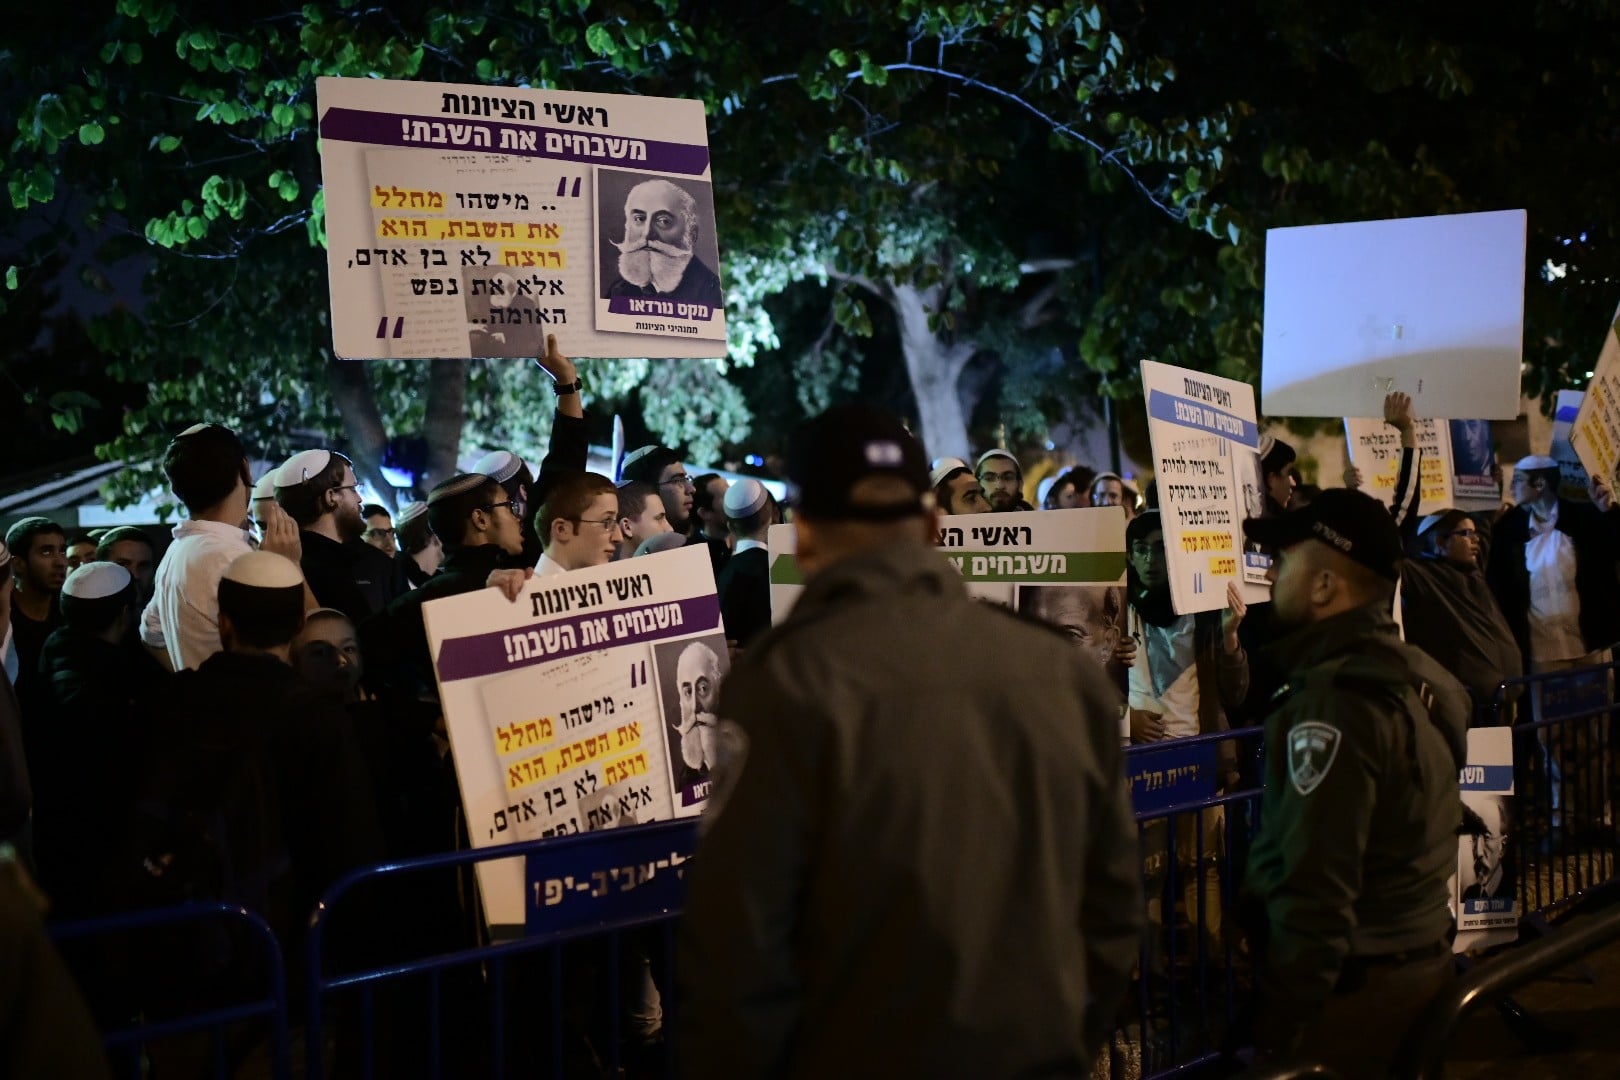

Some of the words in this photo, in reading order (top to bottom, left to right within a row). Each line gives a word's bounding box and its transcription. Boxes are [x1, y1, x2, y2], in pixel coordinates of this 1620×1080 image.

[441, 93, 536, 120] הציונות
[544, 102, 608, 127] ראשי
[401, 119, 491, 148] השבת!
[500, 128, 537, 151] את
[545, 132, 647, 161] משבחים
[375, 185, 443, 208] מחלל
[456, 192, 529, 210] מישהו
[381, 219, 427, 237] הוא
[440, 221, 515, 240] השבת,
[527, 222, 560, 239] את
[348, 248, 408, 268] אדם,
[420, 248, 448, 269] בן
[460, 245, 491, 266] לא
[504, 250, 561, 268] רוצח
[411, 278, 459, 296] נפש
[472, 278, 503, 296] את
[517, 275, 565, 296] אלא
[629, 299, 674, 315] נורדאו
[677, 303, 709, 320] מקס
[636, 322, 665, 332] הציונות
[667, 324, 698, 334] ממנהיגי
[1183, 377, 1213, 402] הציונות
[1213, 387, 1232, 409] ראשי
[1174, 400, 1203, 426] השבת!
[1203, 409, 1216, 429] את
[1216, 413, 1244, 437] משבחים
[1162, 455, 1187, 473] להיות
[1189, 459, 1207, 476] צורך
[1168, 484, 1197, 502] מדקדק
[1198, 485, 1208, 499] או
[971, 526, 1032, 547] ראשי
[971, 554, 1067, 576] משבחים
[606, 573, 653, 601] ראשי
[530, 582, 604, 617] הציונות
[580, 617, 611, 646] את
[612, 603, 684, 639] משבחים
[504, 625, 578, 663] השבת!
[560, 695, 615, 730] מישהו
[496, 718, 553, 752] מחלל
[617, 721, 641, 747] את
[556, 732, 610, 774] השבת,
[508, 757, 546, 788] הוא
[605, 754, 647, 786] רוצח
[574, 769, 597, 799] לא
[544, 787, 567, 815] בן
[618, 785, 653, 816] אלא
[489, 798, 537, 840] אדם,
[587, 803, 613, 831] את
[533, 852, 692, 908] ל-אביב-יפו
